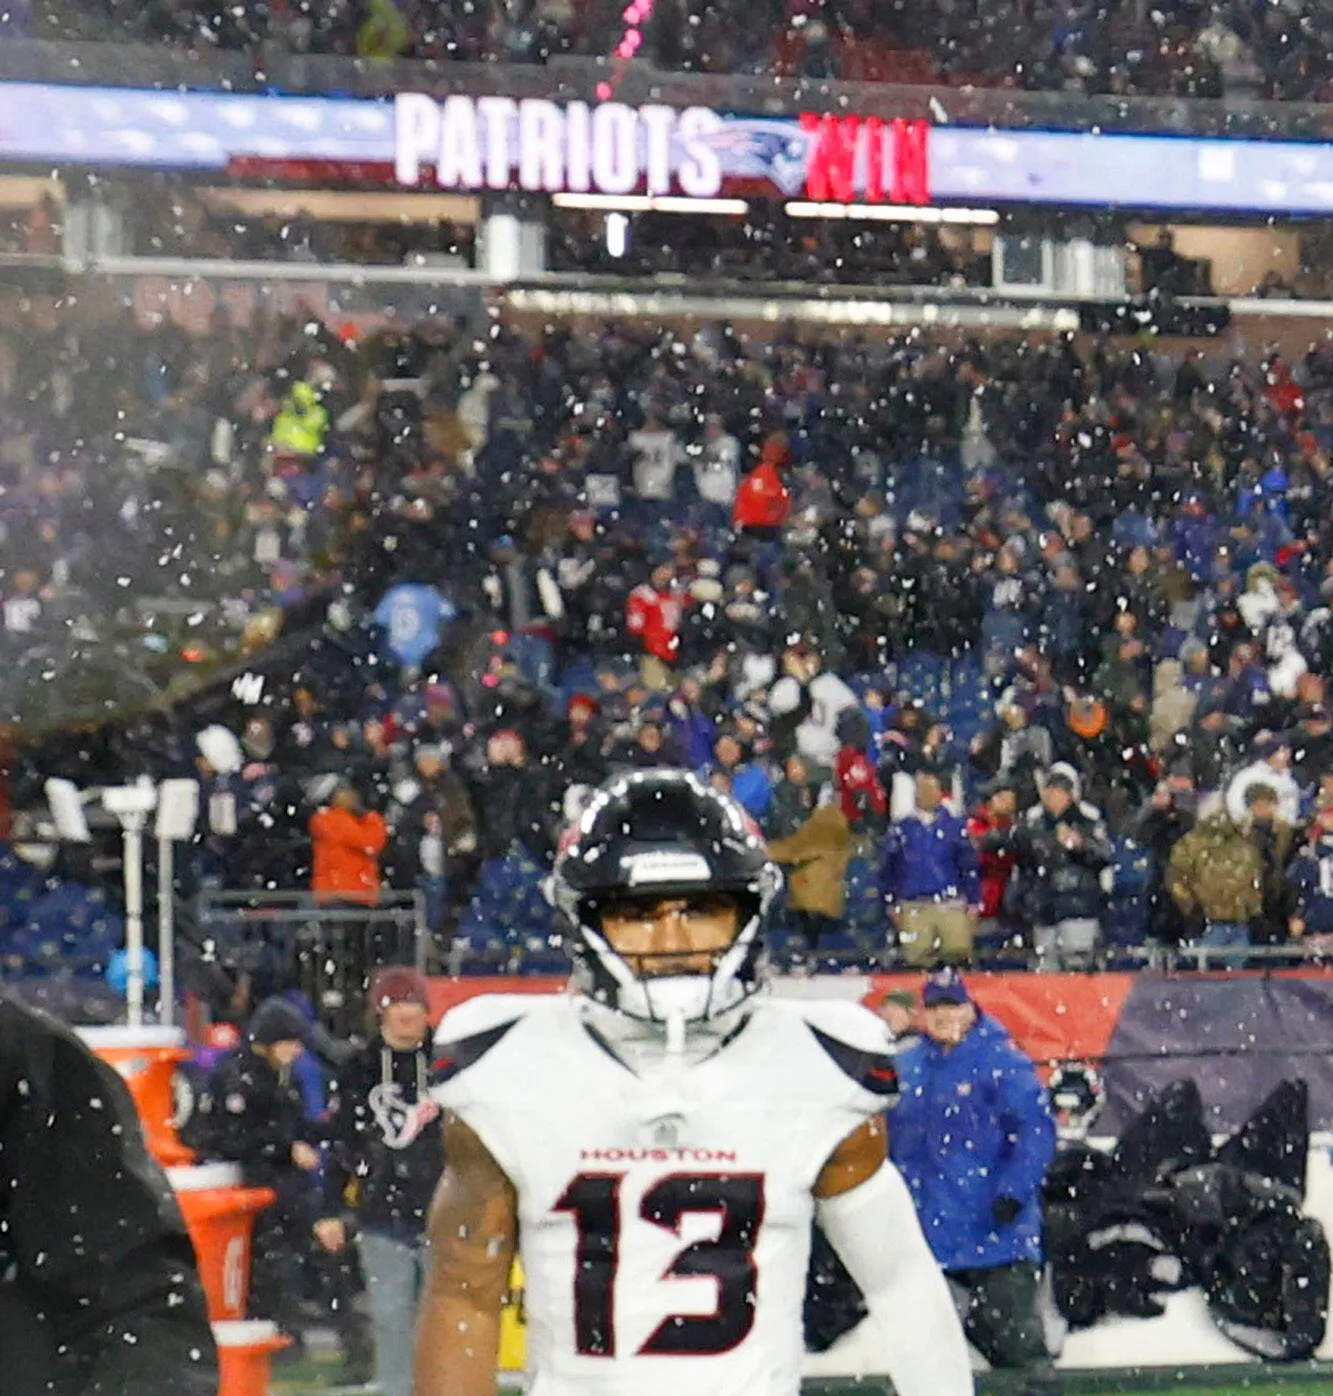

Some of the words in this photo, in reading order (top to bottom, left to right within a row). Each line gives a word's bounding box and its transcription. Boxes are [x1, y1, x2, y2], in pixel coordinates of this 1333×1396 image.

[395, 92, 722, 196] PATRIOTS
[799, 111, 931, 204] WIN
[580, 1148, 737, 1162] HOUSTON
[548, 1171, 766, 1358] 13
